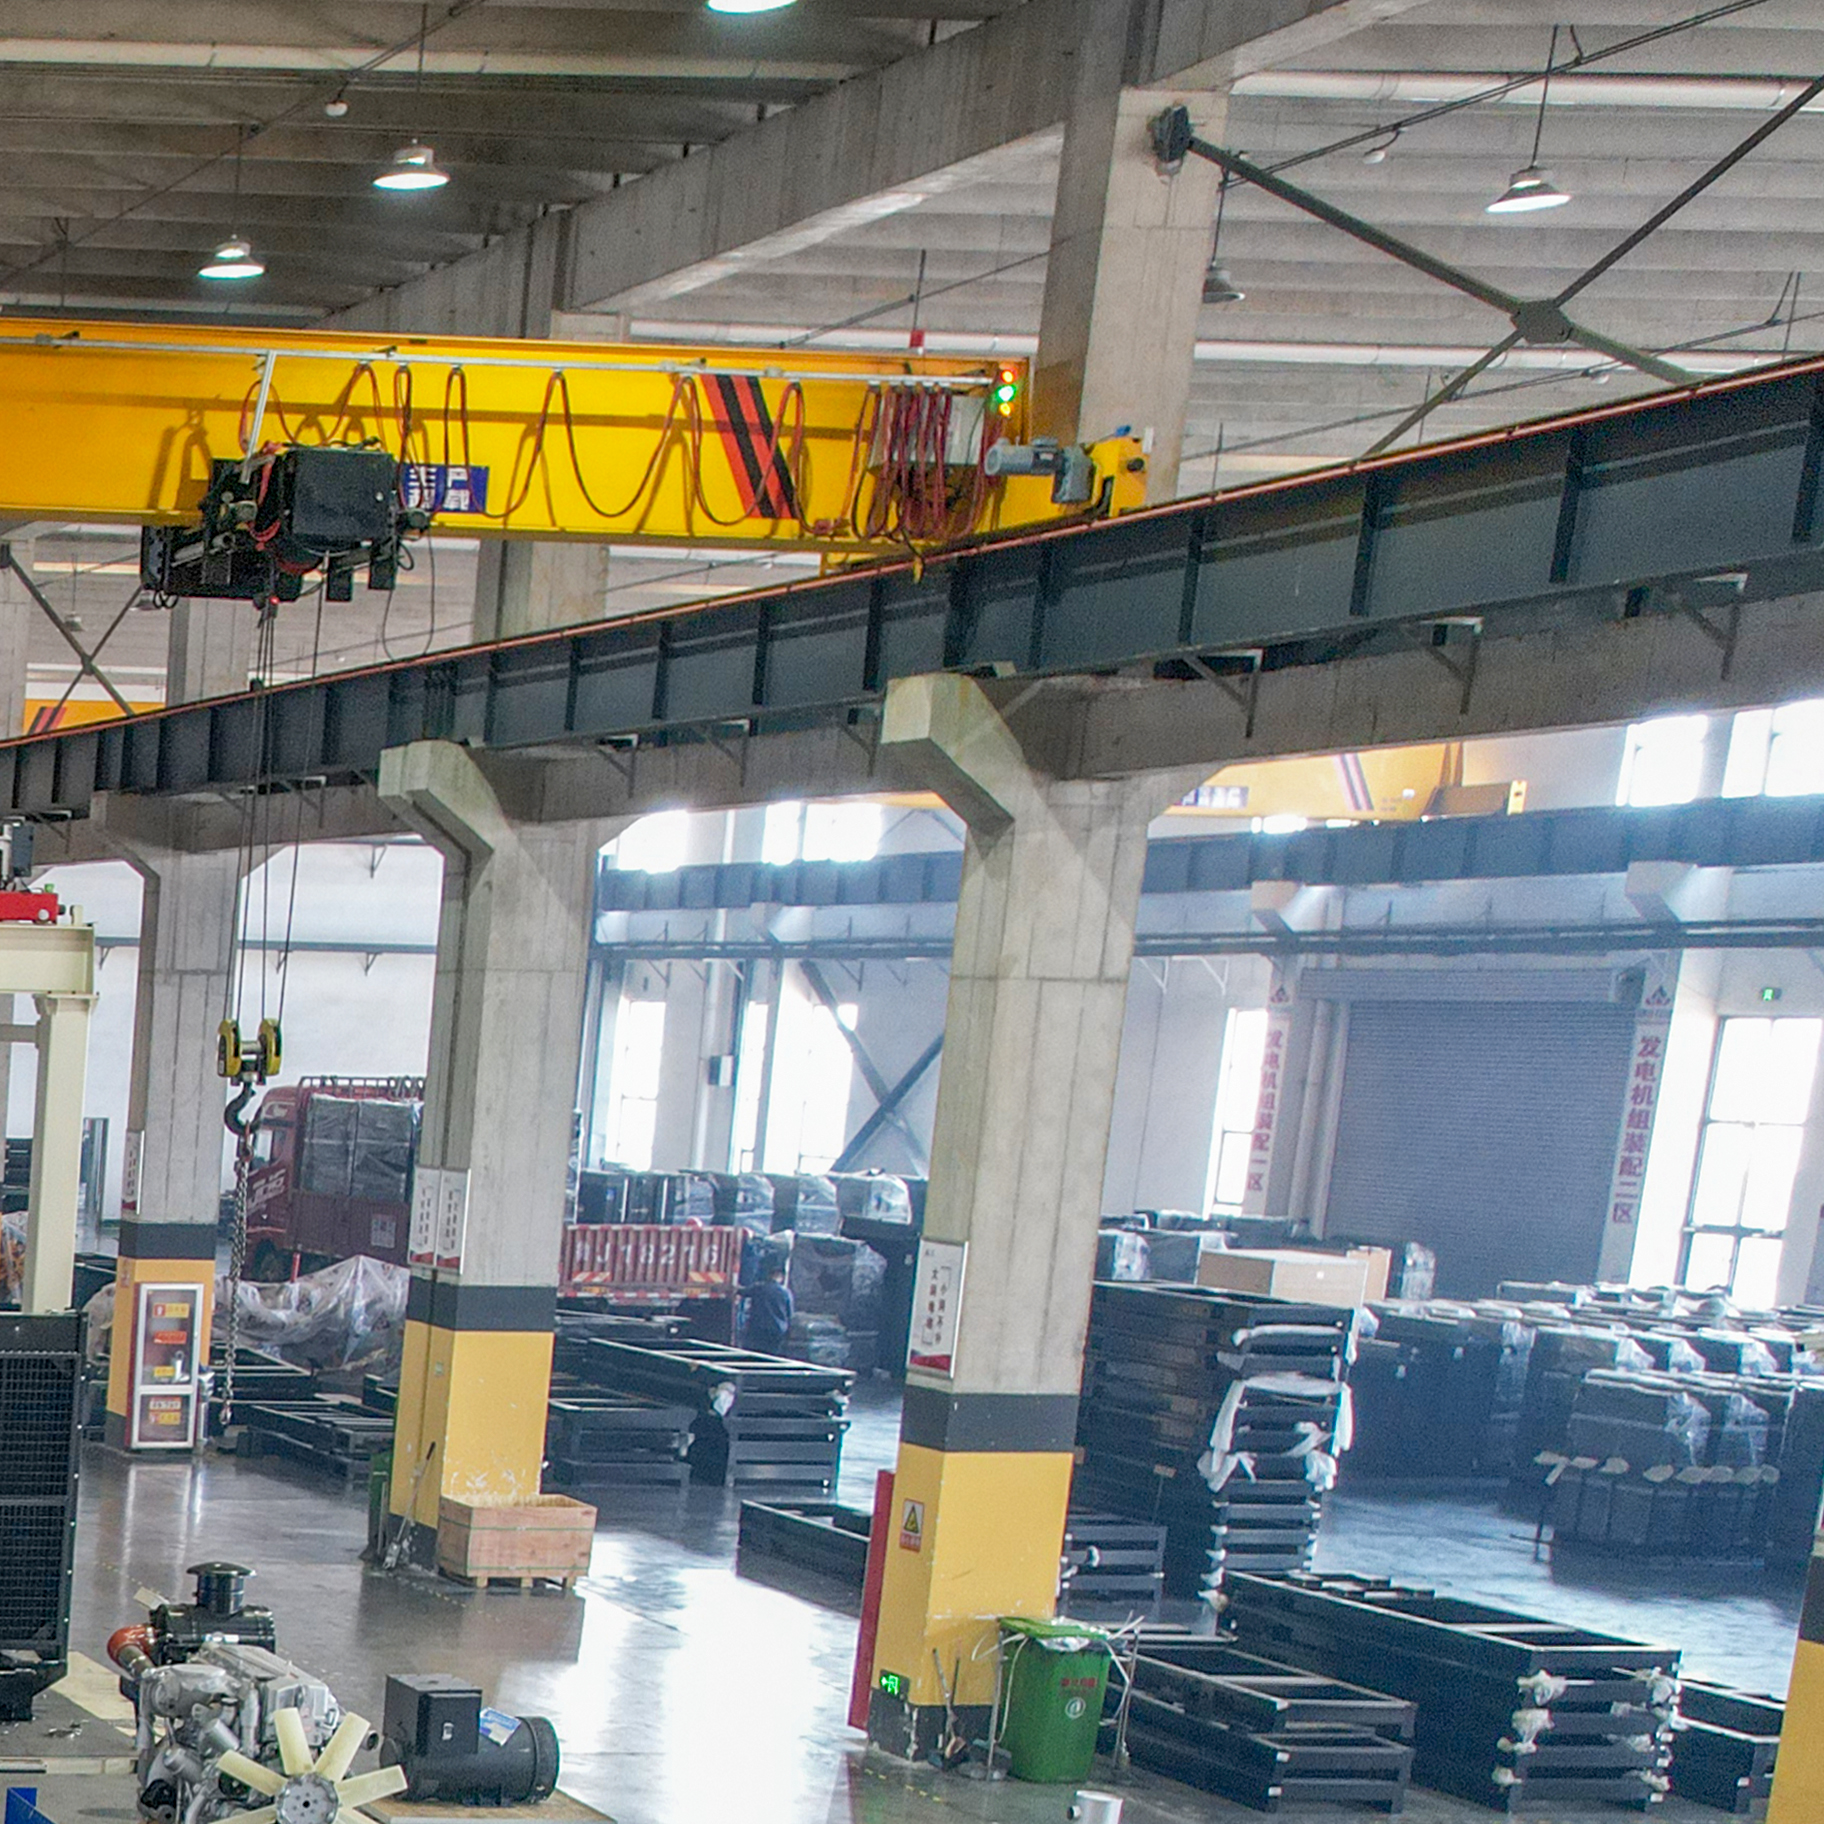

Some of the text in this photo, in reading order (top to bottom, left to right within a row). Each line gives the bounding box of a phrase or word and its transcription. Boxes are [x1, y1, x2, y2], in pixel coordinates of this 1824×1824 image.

[1612, 1035, 1662, 1224] 发电机组装配二区
